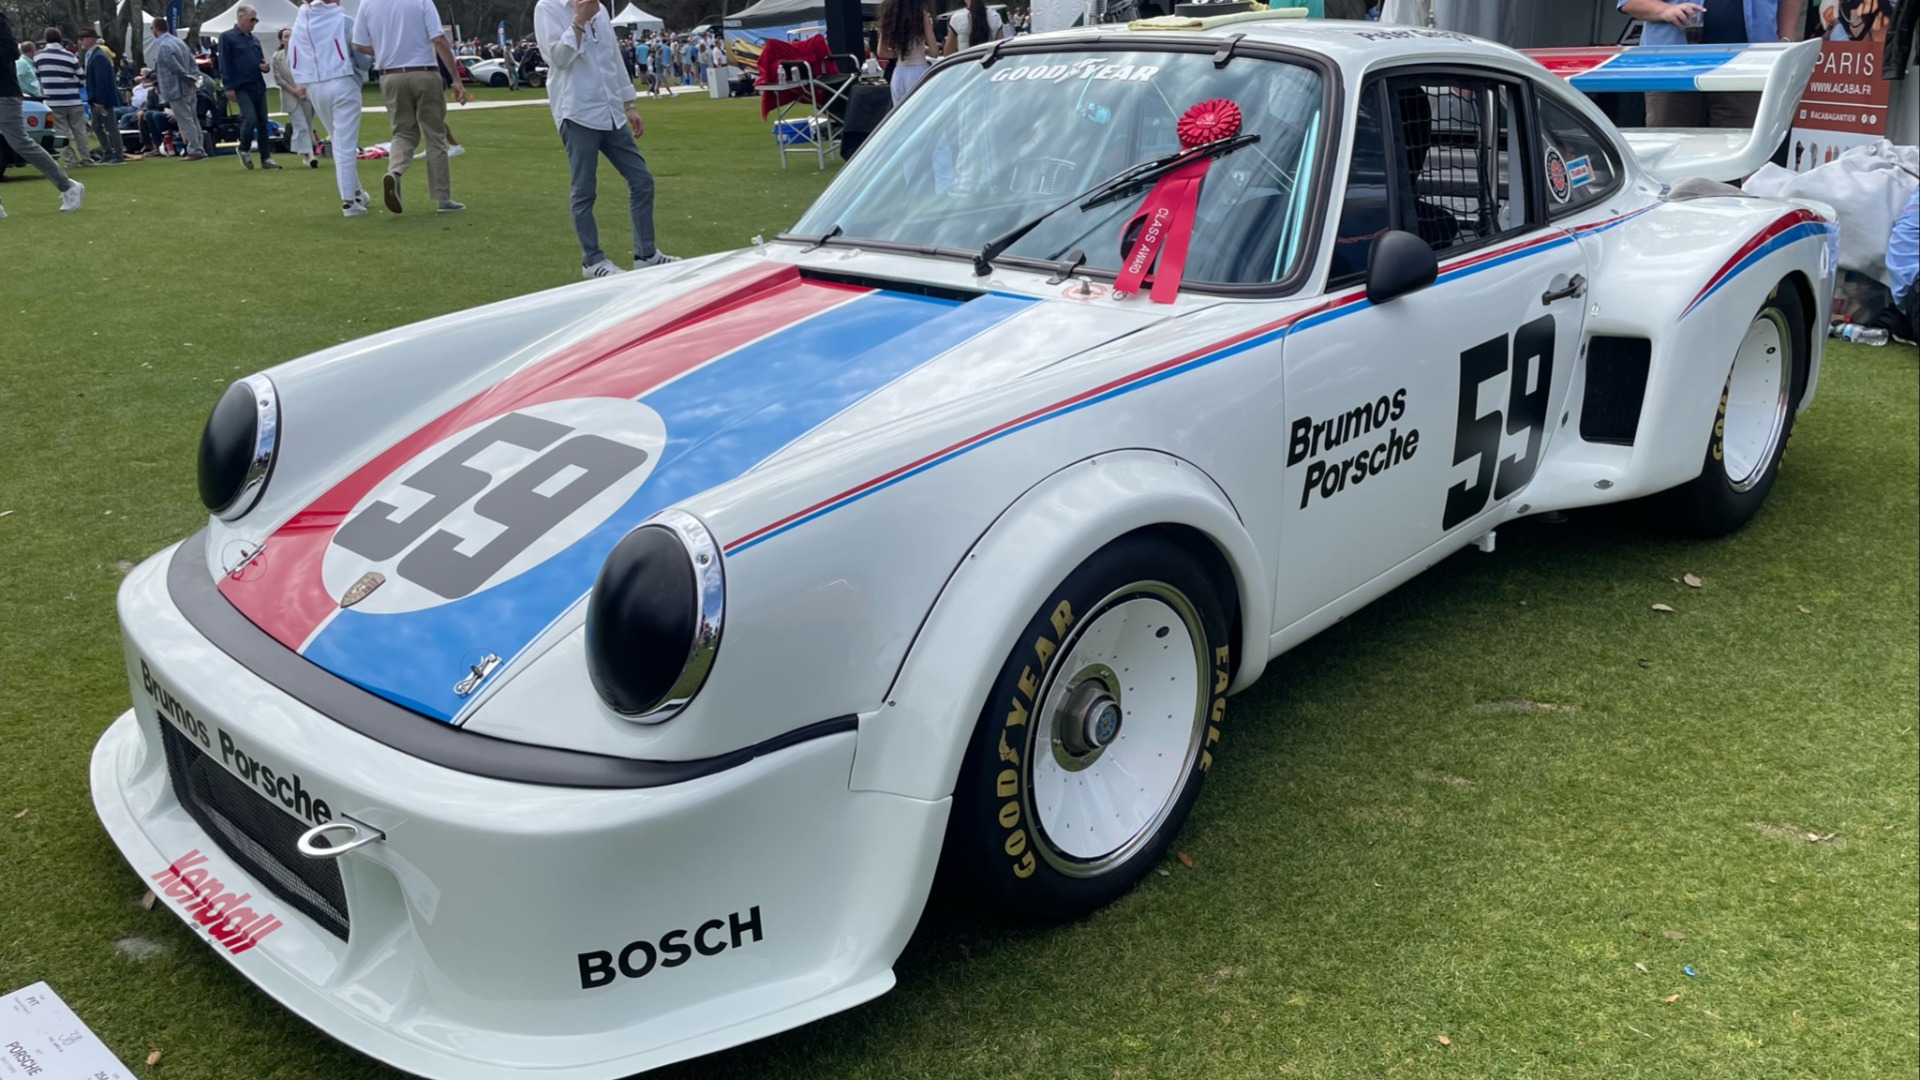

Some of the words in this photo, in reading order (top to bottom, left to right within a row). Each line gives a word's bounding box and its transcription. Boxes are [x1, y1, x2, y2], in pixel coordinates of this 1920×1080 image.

[990, 58, 1160, 84] GOODYEAR
[1810, 82, 1872, 95] WWW.ACABA.FR
[1811, 52, 1875, 76] PARIS
[1128, 243, 1151, 274] AWARD
[1145, 207, 1170, 244] CLASS
[1286, 387, 1407, 468] Brumos
[1442, 313, 1556, 532] 59
[332, 412, 649, 600] 59
[1300, 427, 1420, 510] Porsche
[140, 656, 211, 749] Brumos
[217, 727, 332, 826] Porsche
[996, 600, 1075, 879] GOODYEAR
[1198, 644, 1229, 773] EAGLE
[150, 848, 284, 956] Kendall
[577, 904, 764, 990] BOSCH
[5, 1040, 43, 1077] PORSCHE
